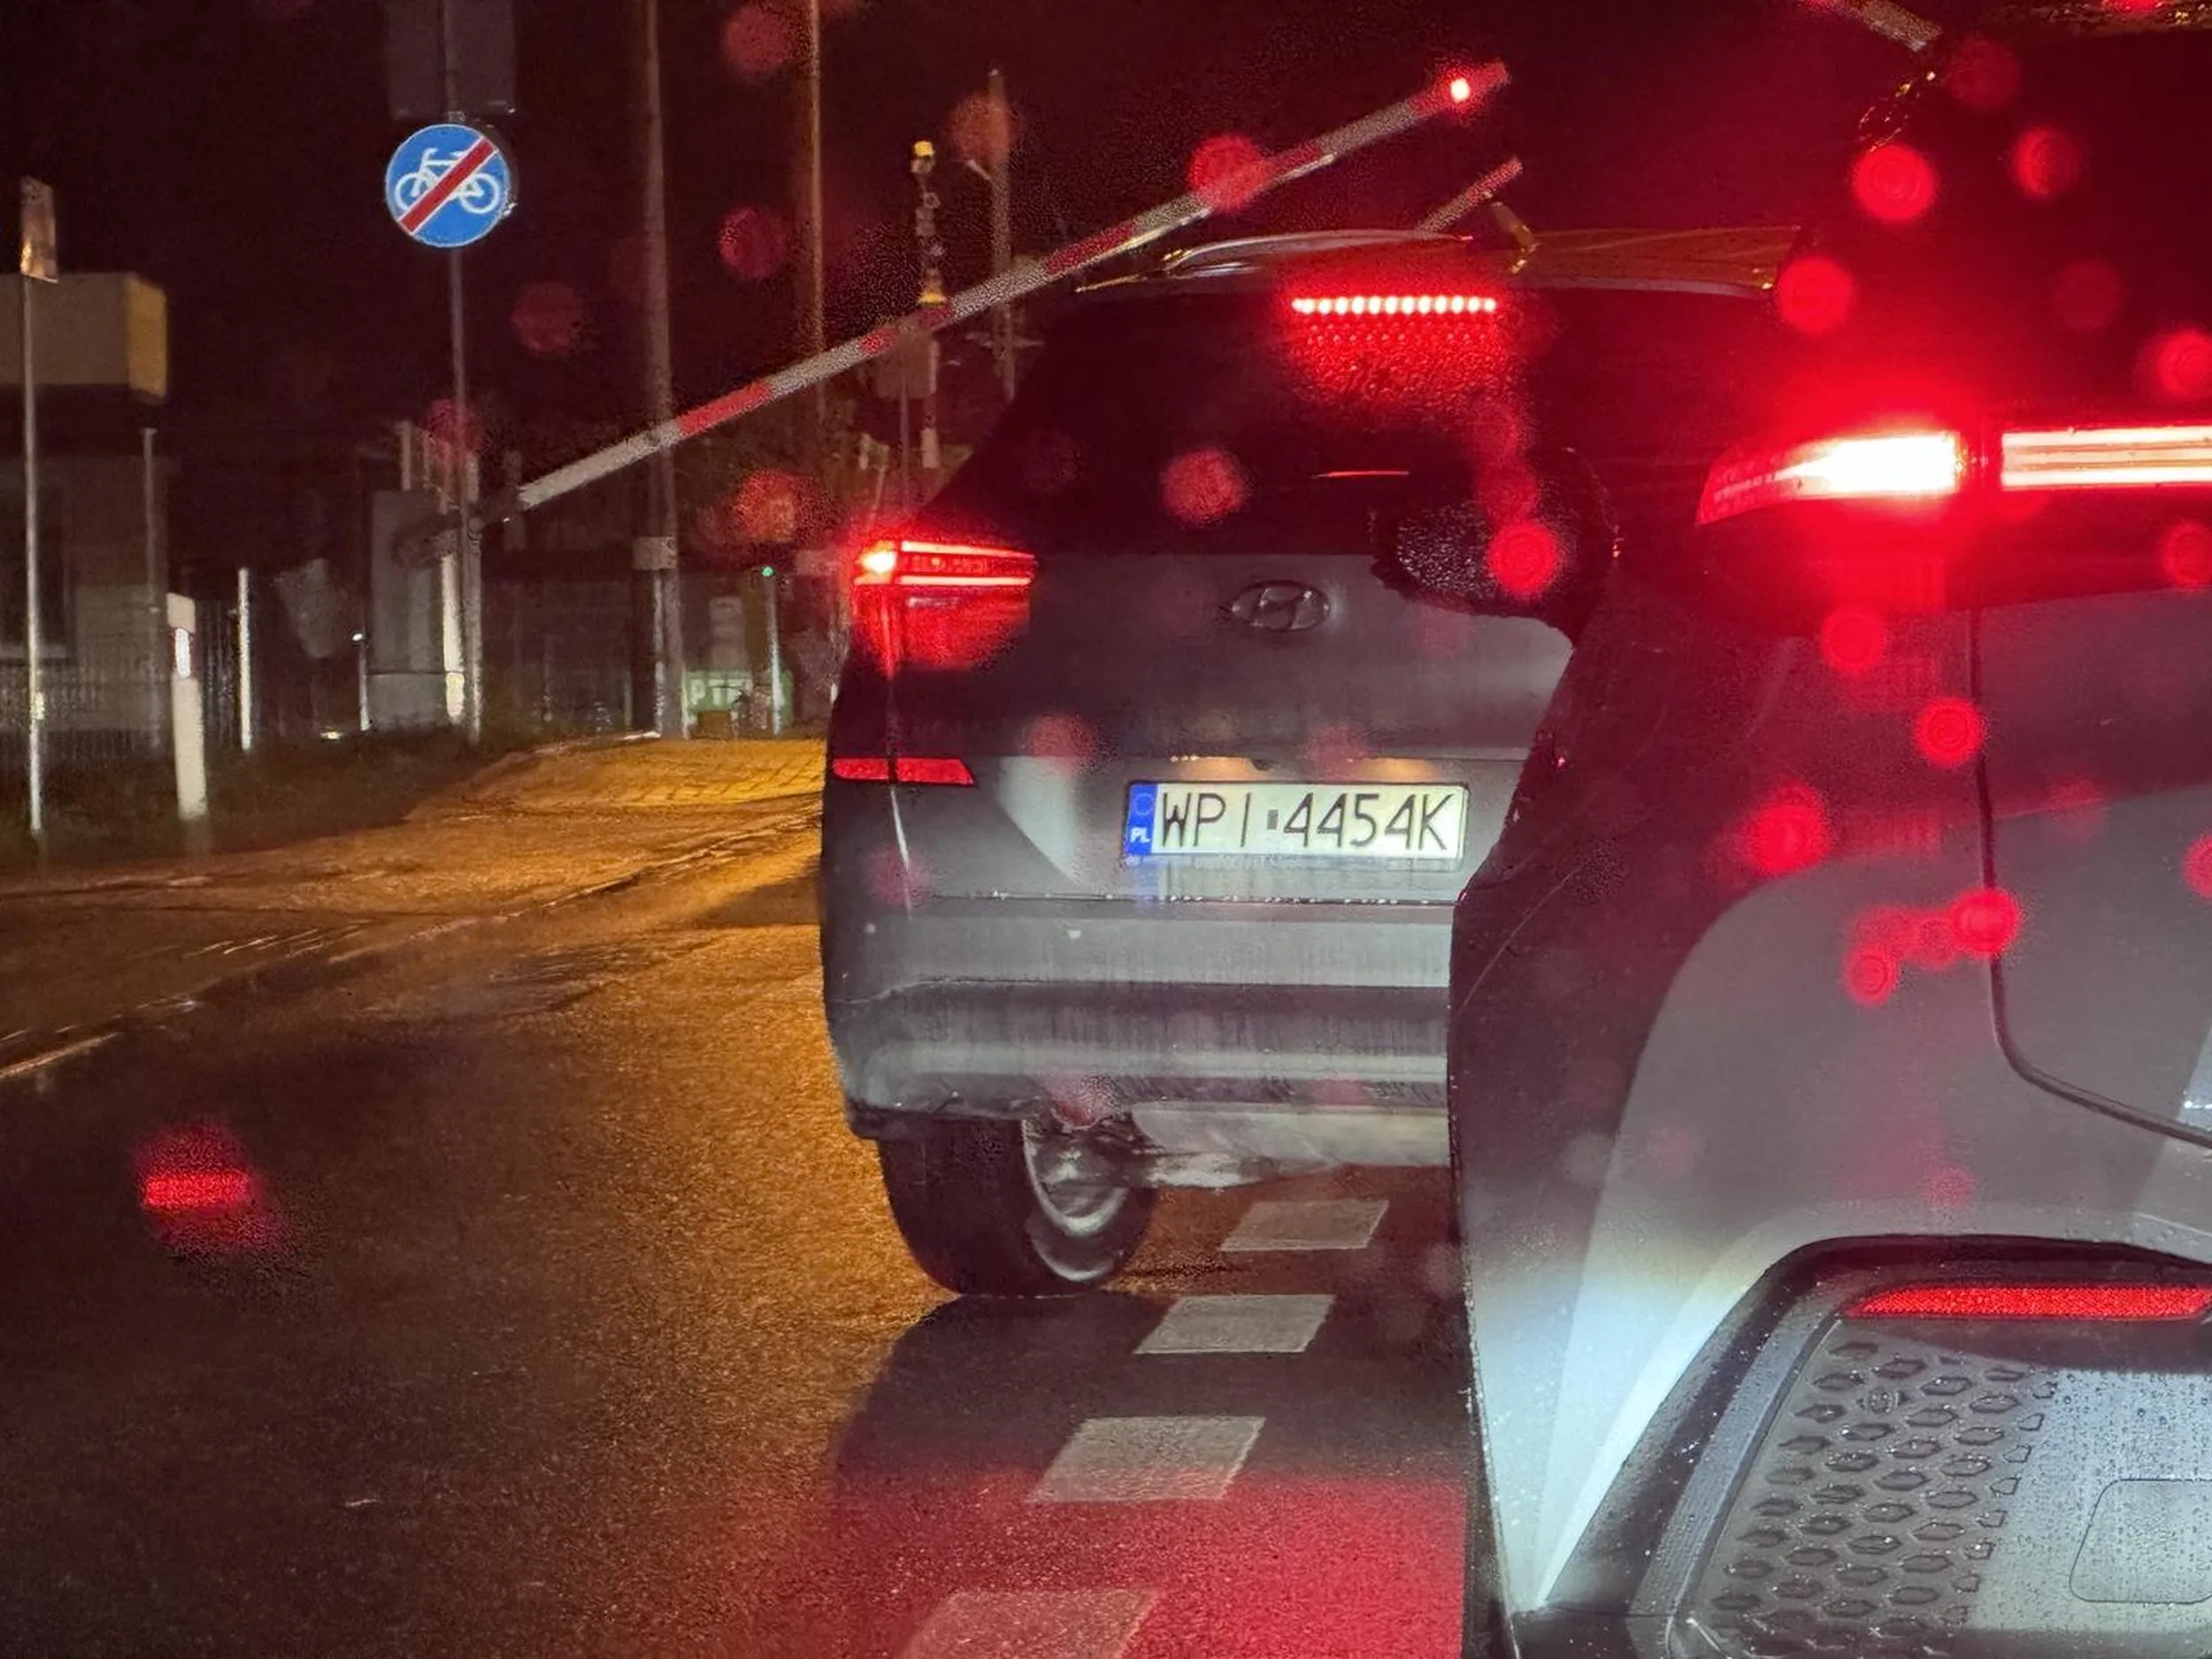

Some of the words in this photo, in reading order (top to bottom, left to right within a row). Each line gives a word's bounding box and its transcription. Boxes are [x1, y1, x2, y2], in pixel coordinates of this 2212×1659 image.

[1130, 826, 1150, 843] PL
[1162, 791, 1252, 848] WPI
[1282, 791, 1455, 851] 4454K
